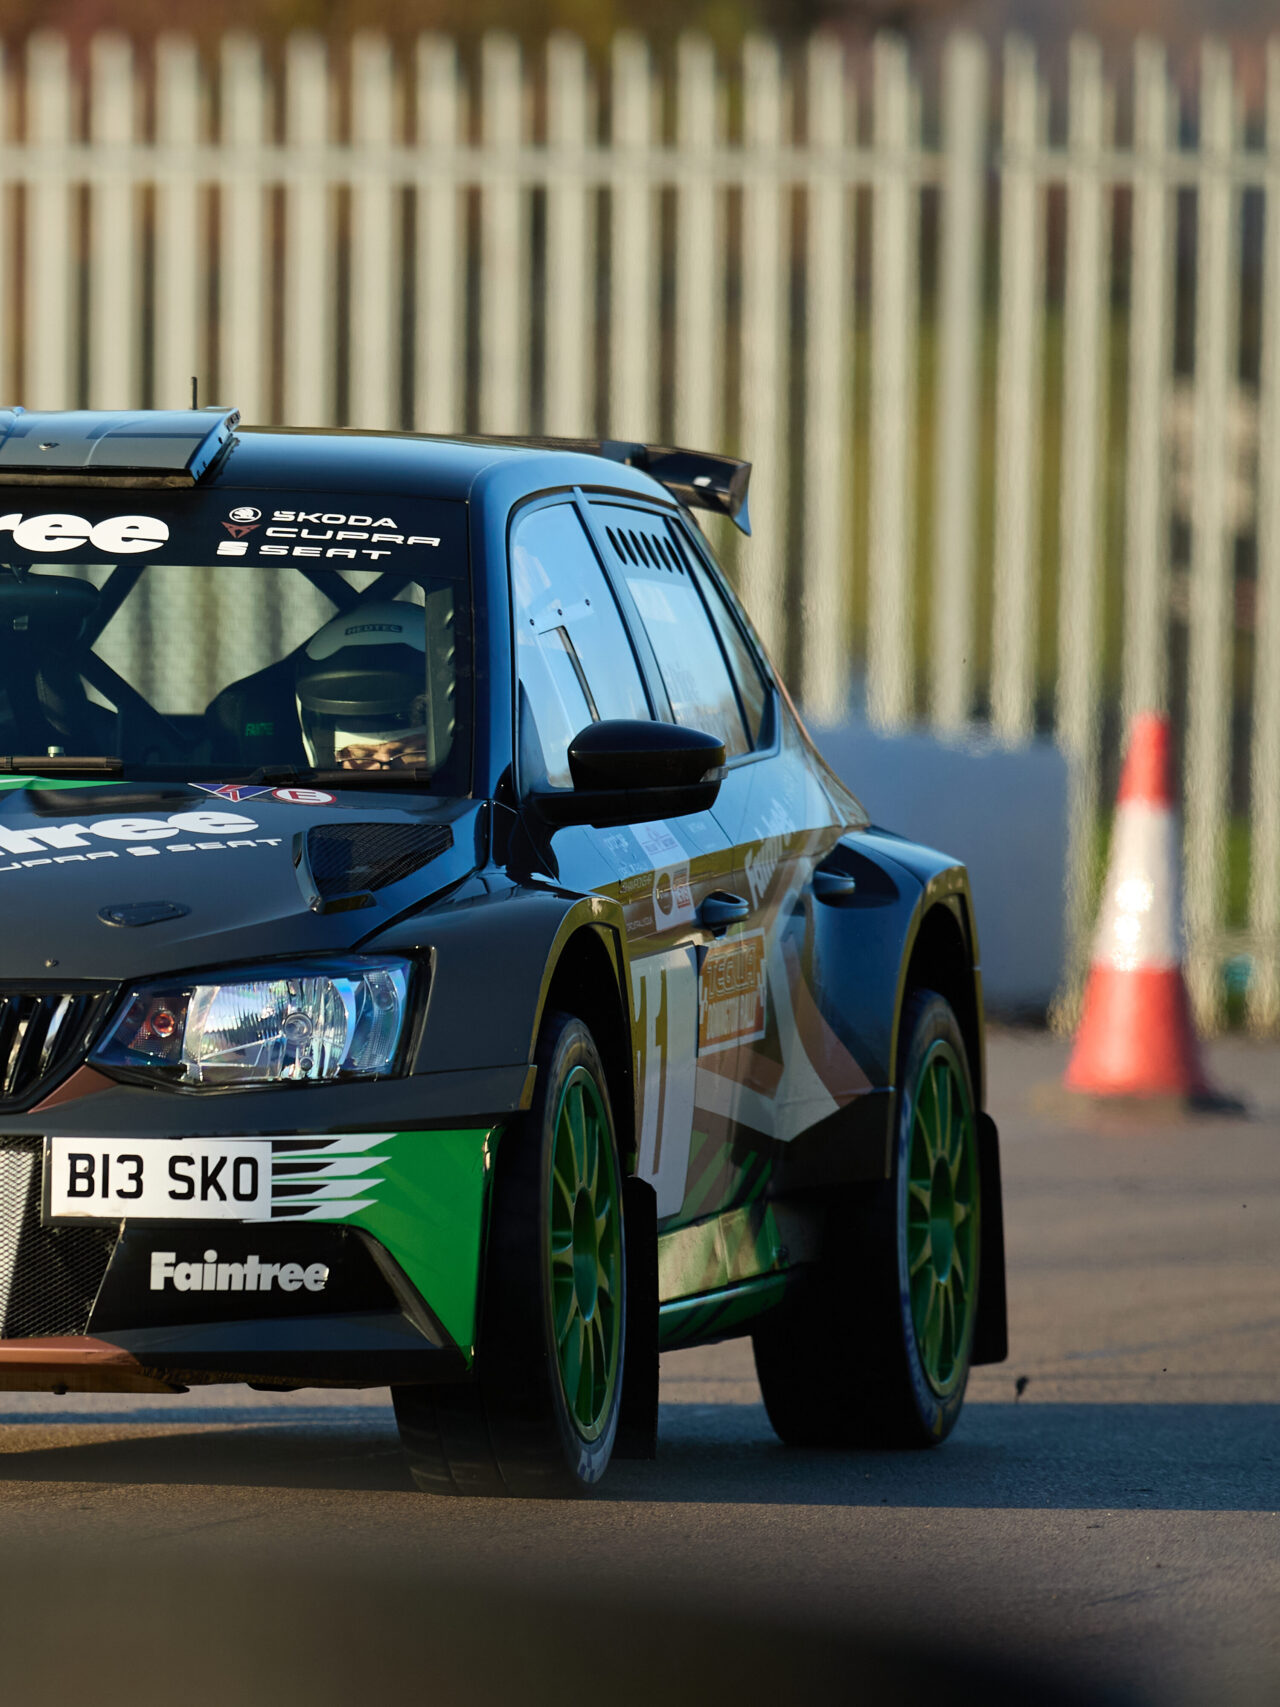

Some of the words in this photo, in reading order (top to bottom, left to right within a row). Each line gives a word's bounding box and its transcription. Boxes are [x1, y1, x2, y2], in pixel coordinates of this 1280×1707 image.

[266, 526, 441, 547] CUPRA
[259, 544, 392, 560] SEAT
[167, 838, 282, 853] SEAT
[67, 1153, 144, 1199] B13
[168, 1155, 259, 1202] SKO
[150, 1249, 330, 1292] Faintree
